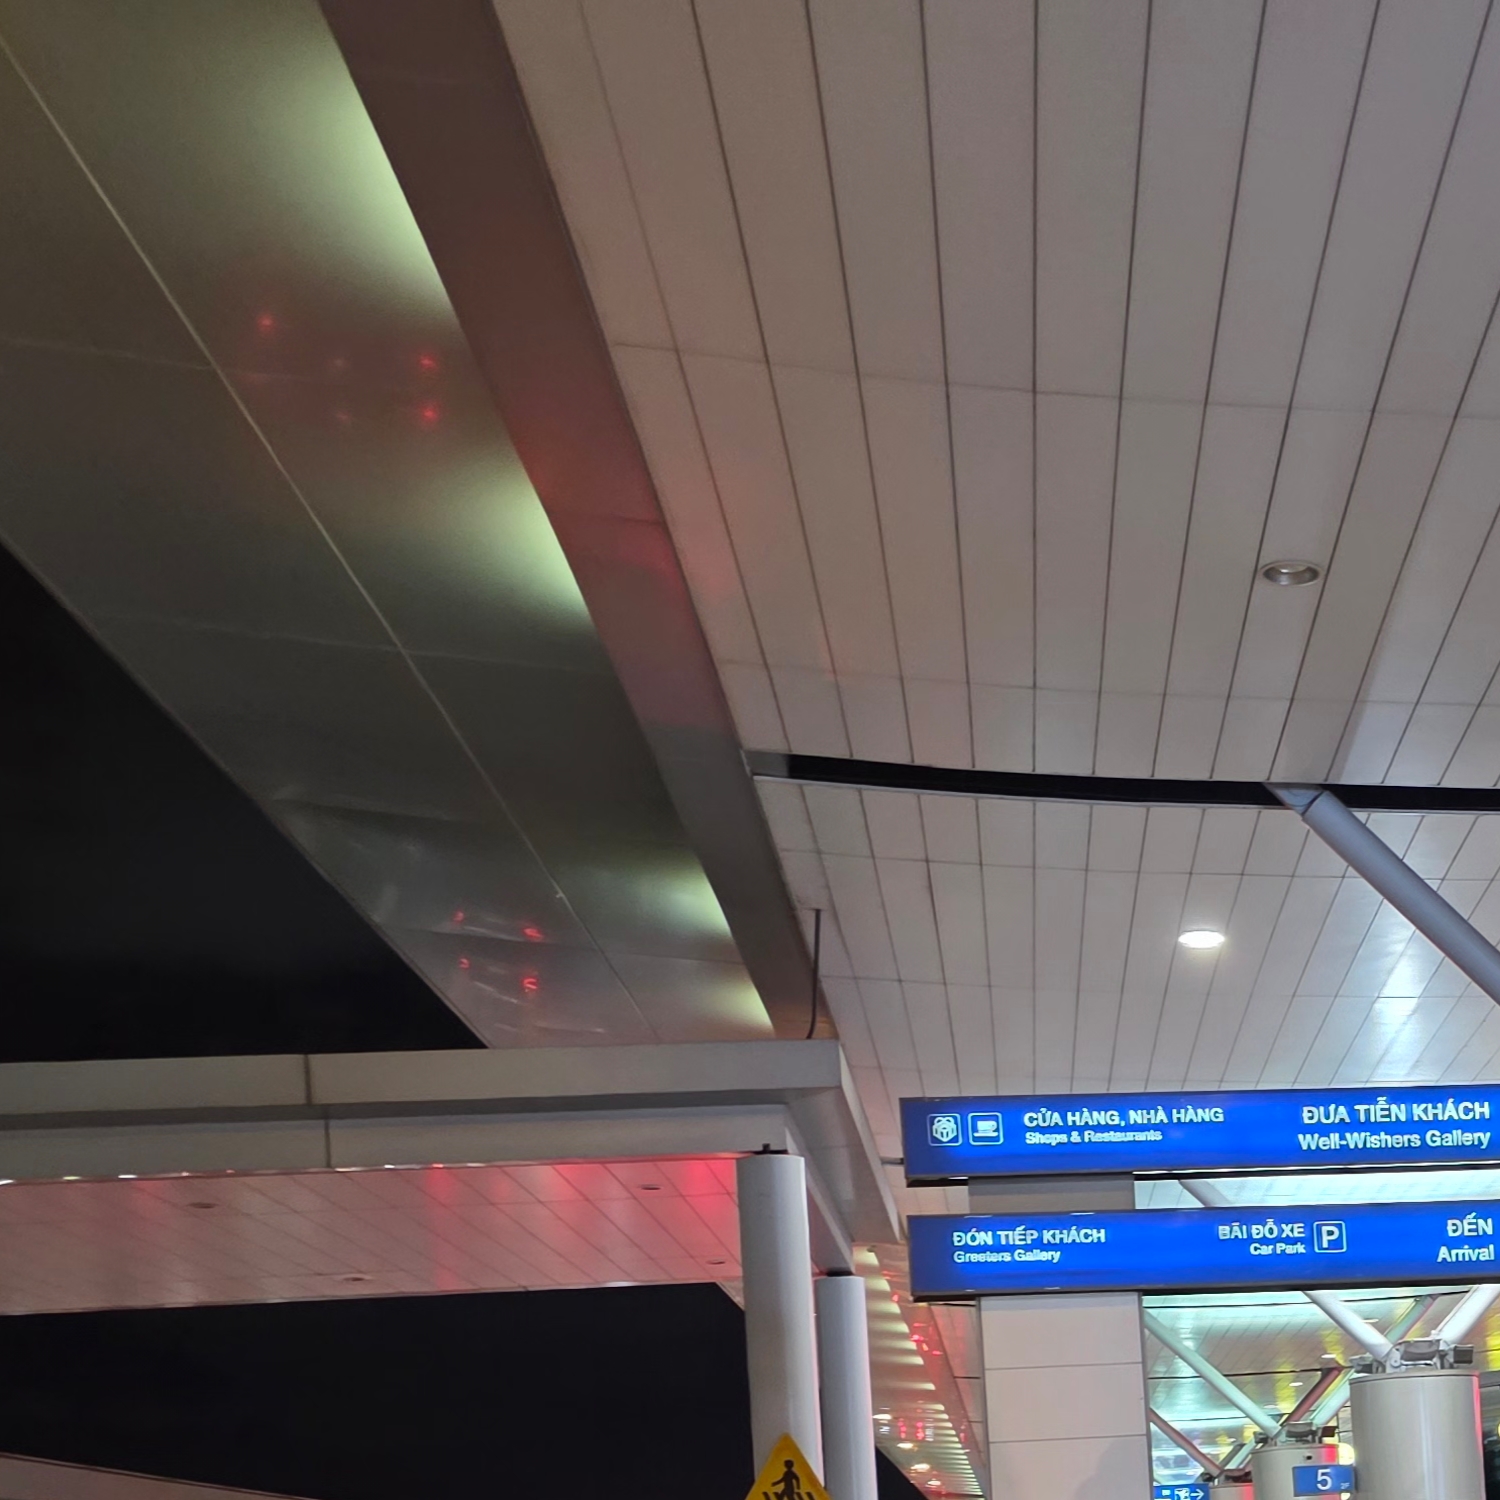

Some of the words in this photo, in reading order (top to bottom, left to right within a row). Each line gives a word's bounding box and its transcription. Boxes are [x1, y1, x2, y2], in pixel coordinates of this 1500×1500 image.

[1023, 1107, 1064, 1128] CỬA
[1066, 1107, 1126, 1127] HÀNG,
[1129, 1105, 1168, 1125] NHÀ
[1172, 1105, 1224, 1123] HÀNG
[1302, 1103, 1351, 1124] ĐƯA
[1354, 1096, 1406, 1123] TIỄN
[1412, 1098, 1491, 1122] KHÁCH
[1025, 1131, 1068, 1146] Shops
[1070, 1131, 1081, 1143] &
[1298, 1131, 1422, 1151] Well-Wishers
[1425, 1129, 1491, 1149] Gallery
[1218, 1222, 1247, 1239] BÃI
[1251, 1219, 1278, 1238] ĐỖ
[1281, 1223, 1305, 1238] XE
[1447, 1213, 1493, 1236] ĐẾN
[952, 1228, 993, 1246] ĐÓN
[996, 1225, 1038, 1245] TIẾP
[1042, 1226, 1106, 1244] KHÁCH
[1013, 1249, 1061, 1263] Gallery
[1250, 1243, 1274, 1255] Car
[1275, 1242, 1306, 1254] Park
[1437, 1245, 1494, 1262] Arrival
[1317, 1469, 1332, 1490] 5
